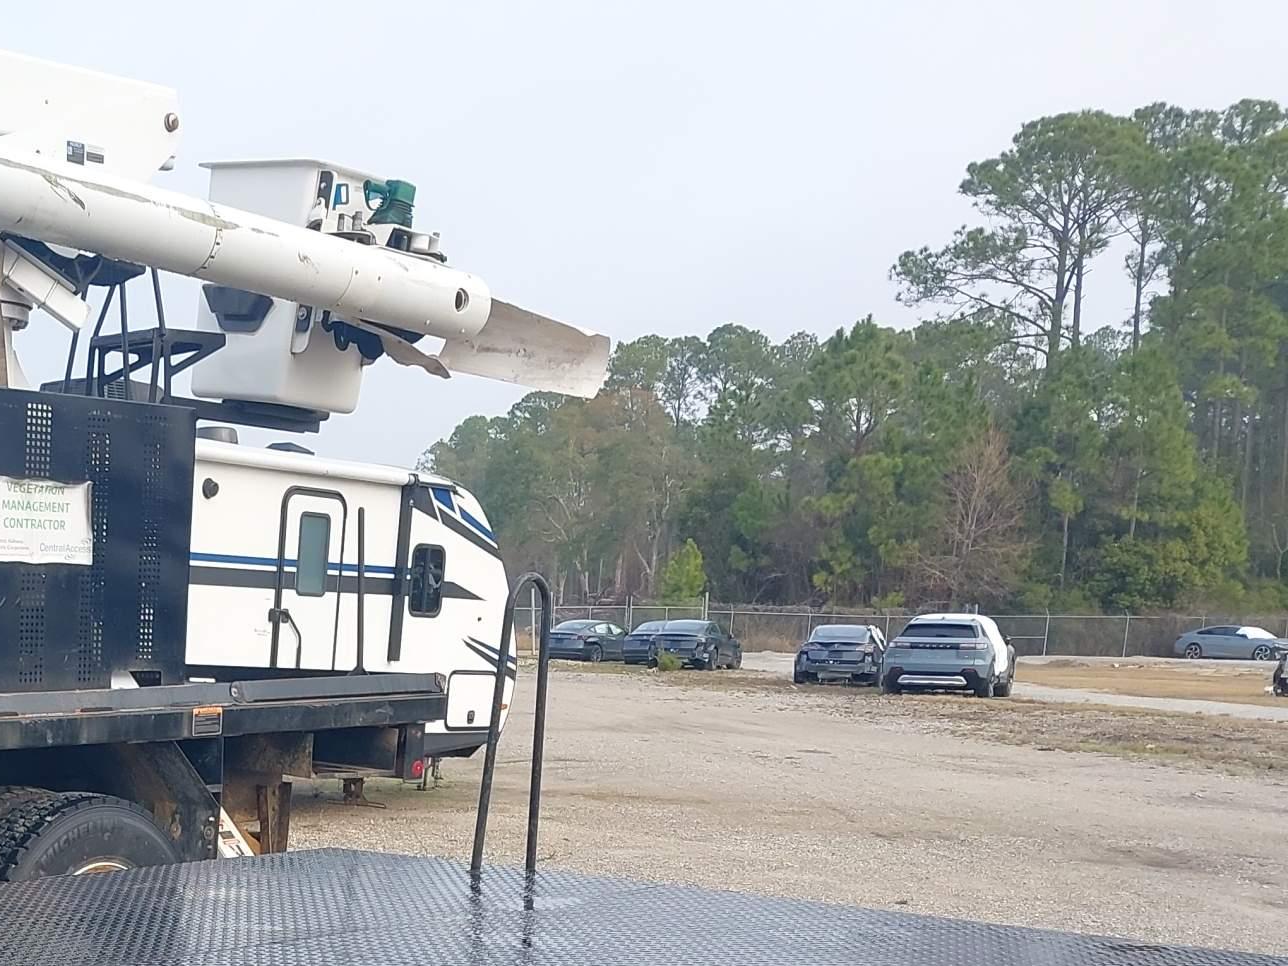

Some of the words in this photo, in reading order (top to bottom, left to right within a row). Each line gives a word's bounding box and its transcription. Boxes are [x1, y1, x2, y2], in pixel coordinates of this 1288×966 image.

[6, 481, 65, 496] VEGETATION
[1, 500, 70, 513] MANAGEMENT
[3, 517, 66, 530] CONTRACTOR
